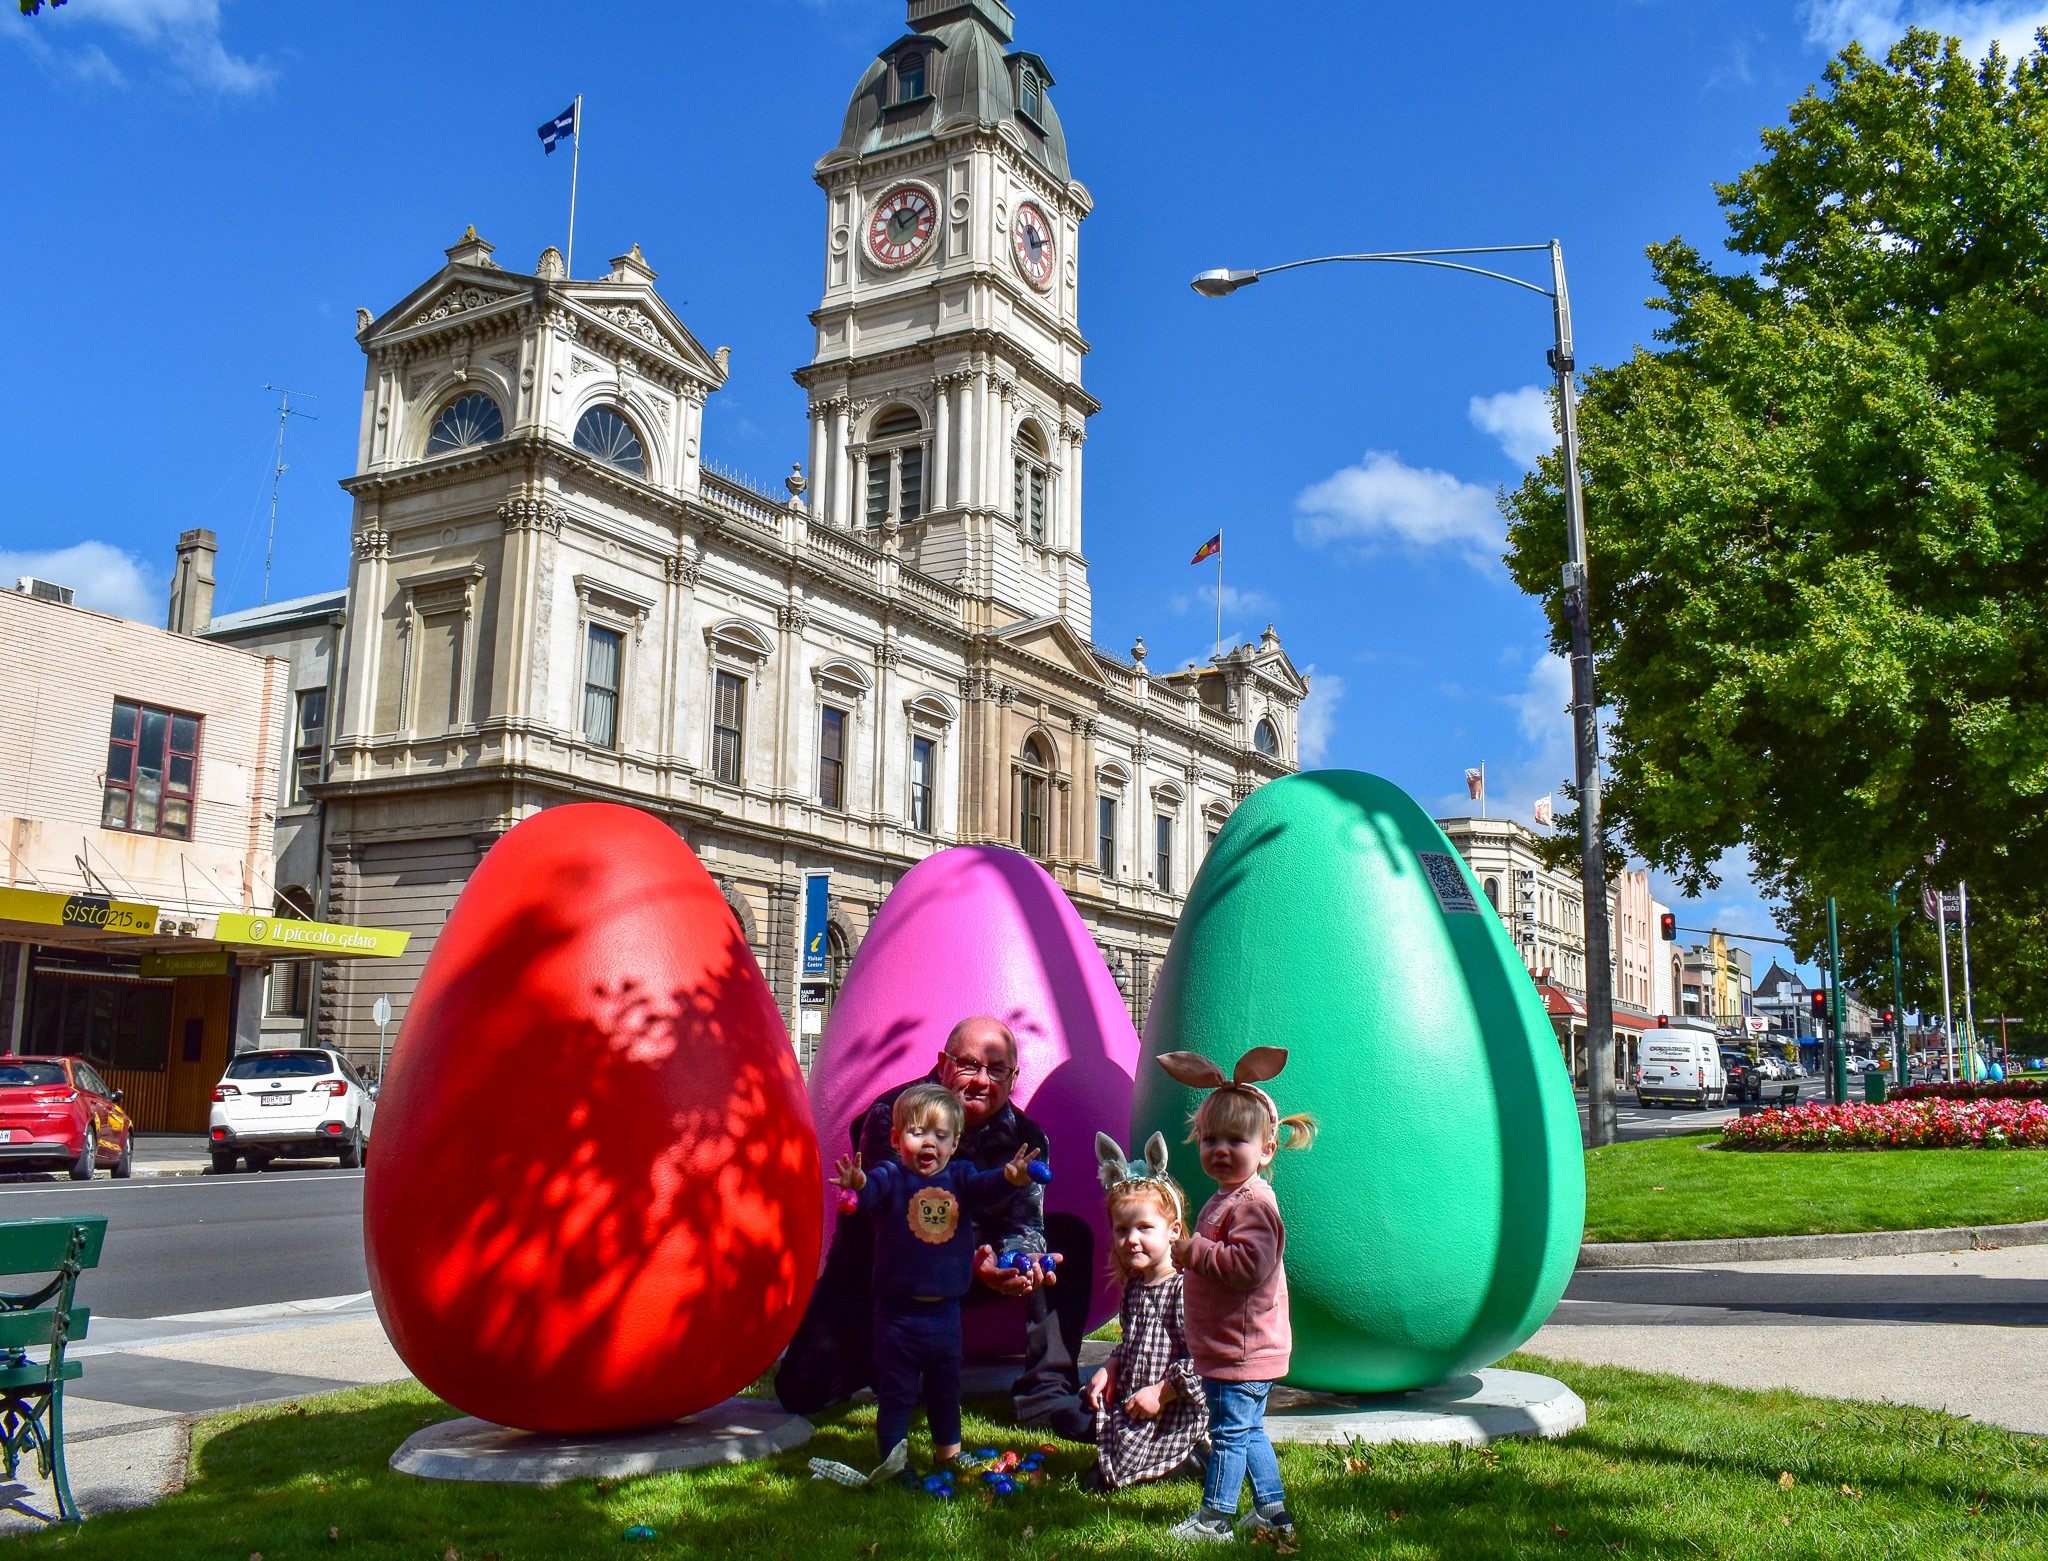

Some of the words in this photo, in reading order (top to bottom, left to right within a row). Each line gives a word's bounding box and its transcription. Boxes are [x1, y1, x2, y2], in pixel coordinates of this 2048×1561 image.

[1520, 870, 1534, 942] MYER
[273, 924, 281, 939] il
[284, 927, 336, 944] piccolo
[171, 957, 196, 971] piccolo
